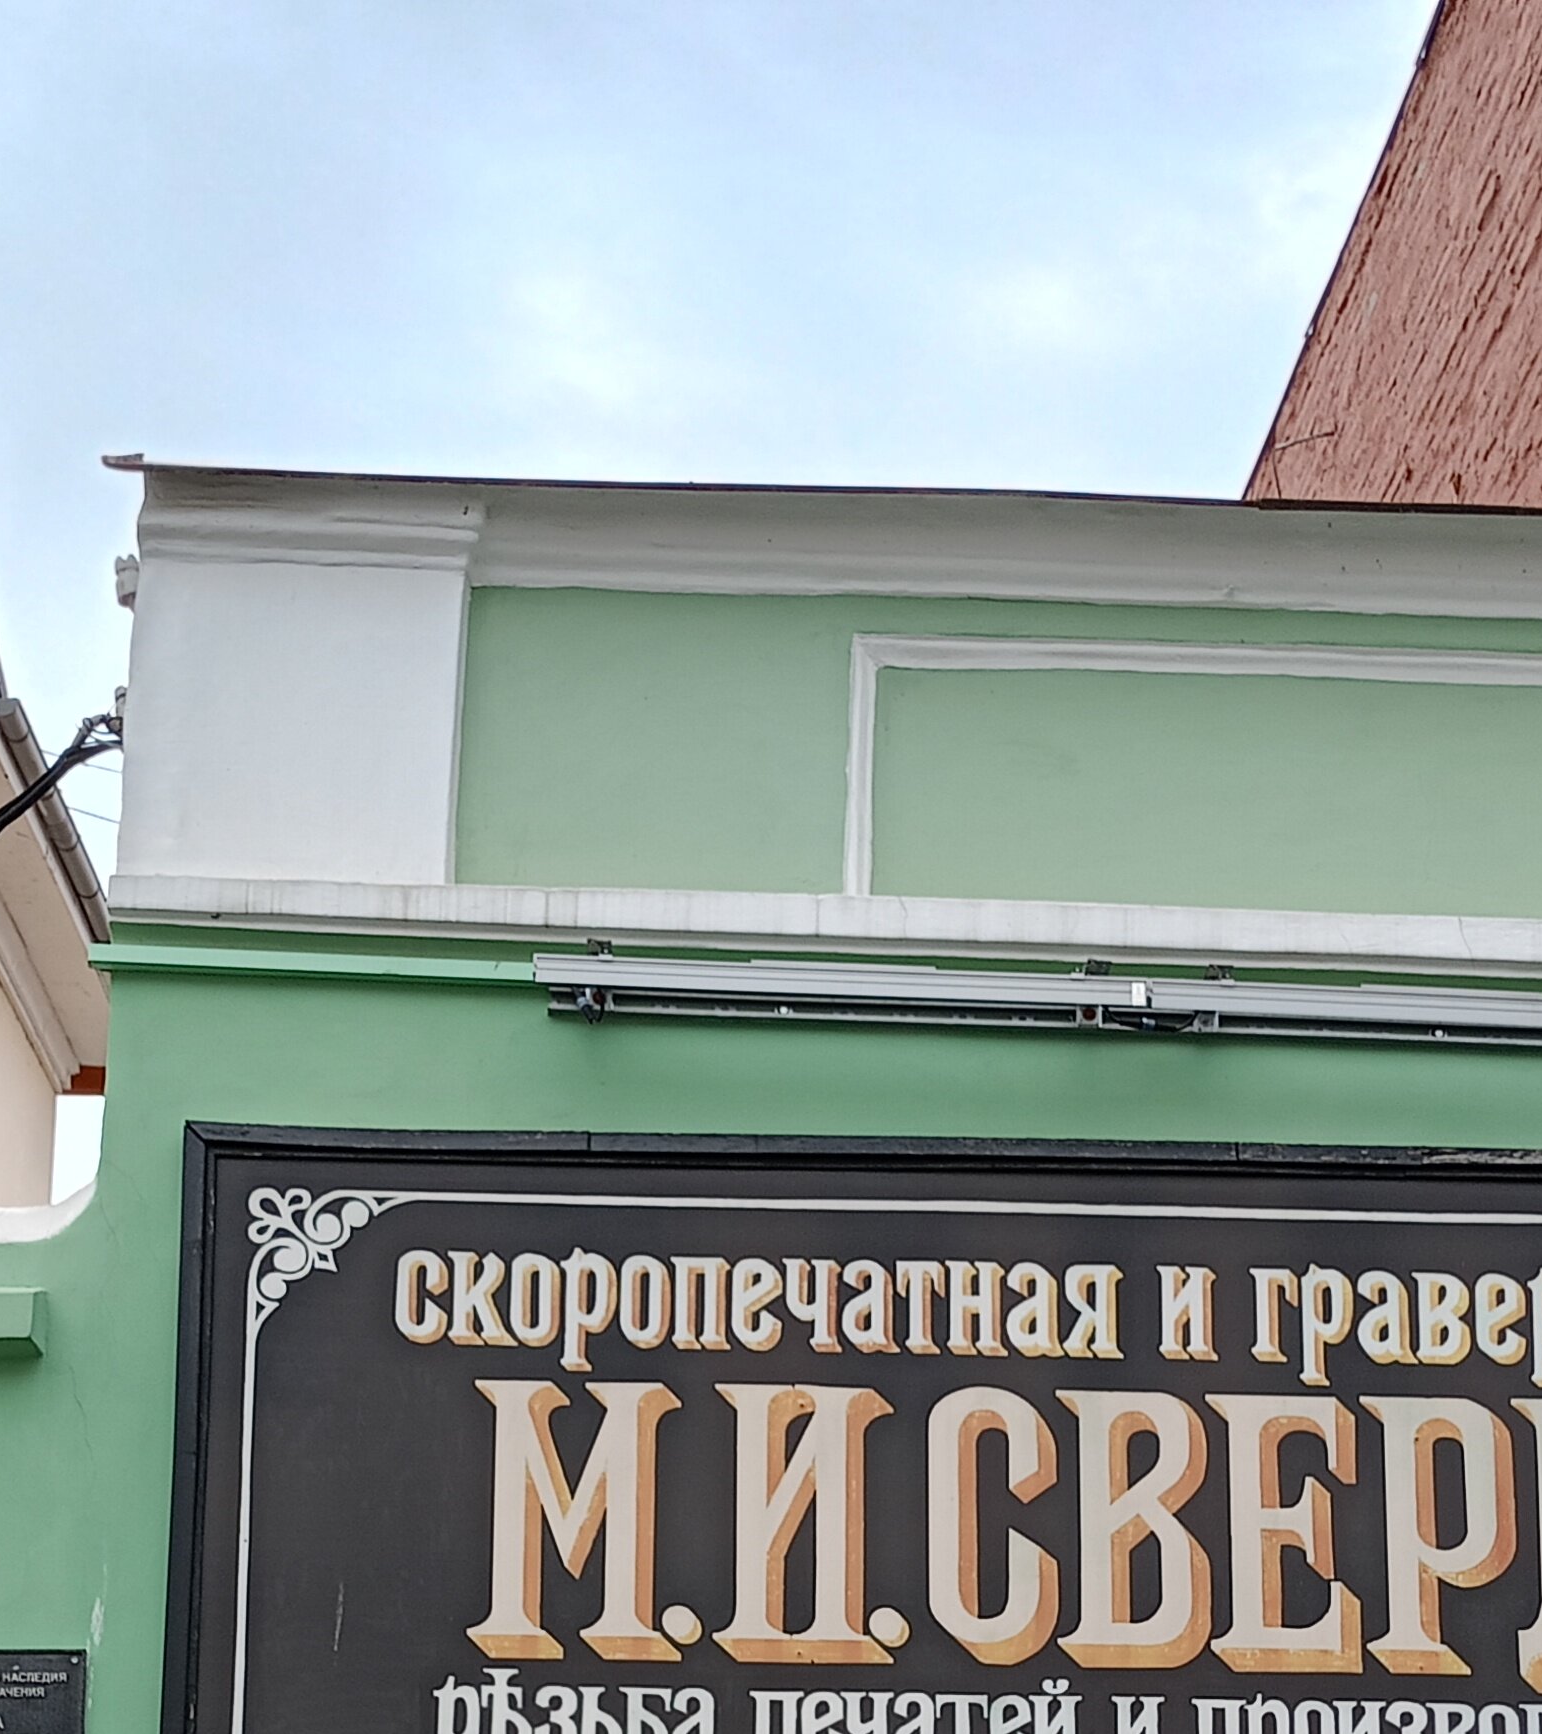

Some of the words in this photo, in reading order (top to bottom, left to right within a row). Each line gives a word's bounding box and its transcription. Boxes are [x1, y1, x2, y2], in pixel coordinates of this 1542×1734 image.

[395, 1247, 1125, 1371] скоропечатная
[1158, 1265, 1220, 1360] и
[2, 1671, 68, 1684] НАСЛЕДИЯ
